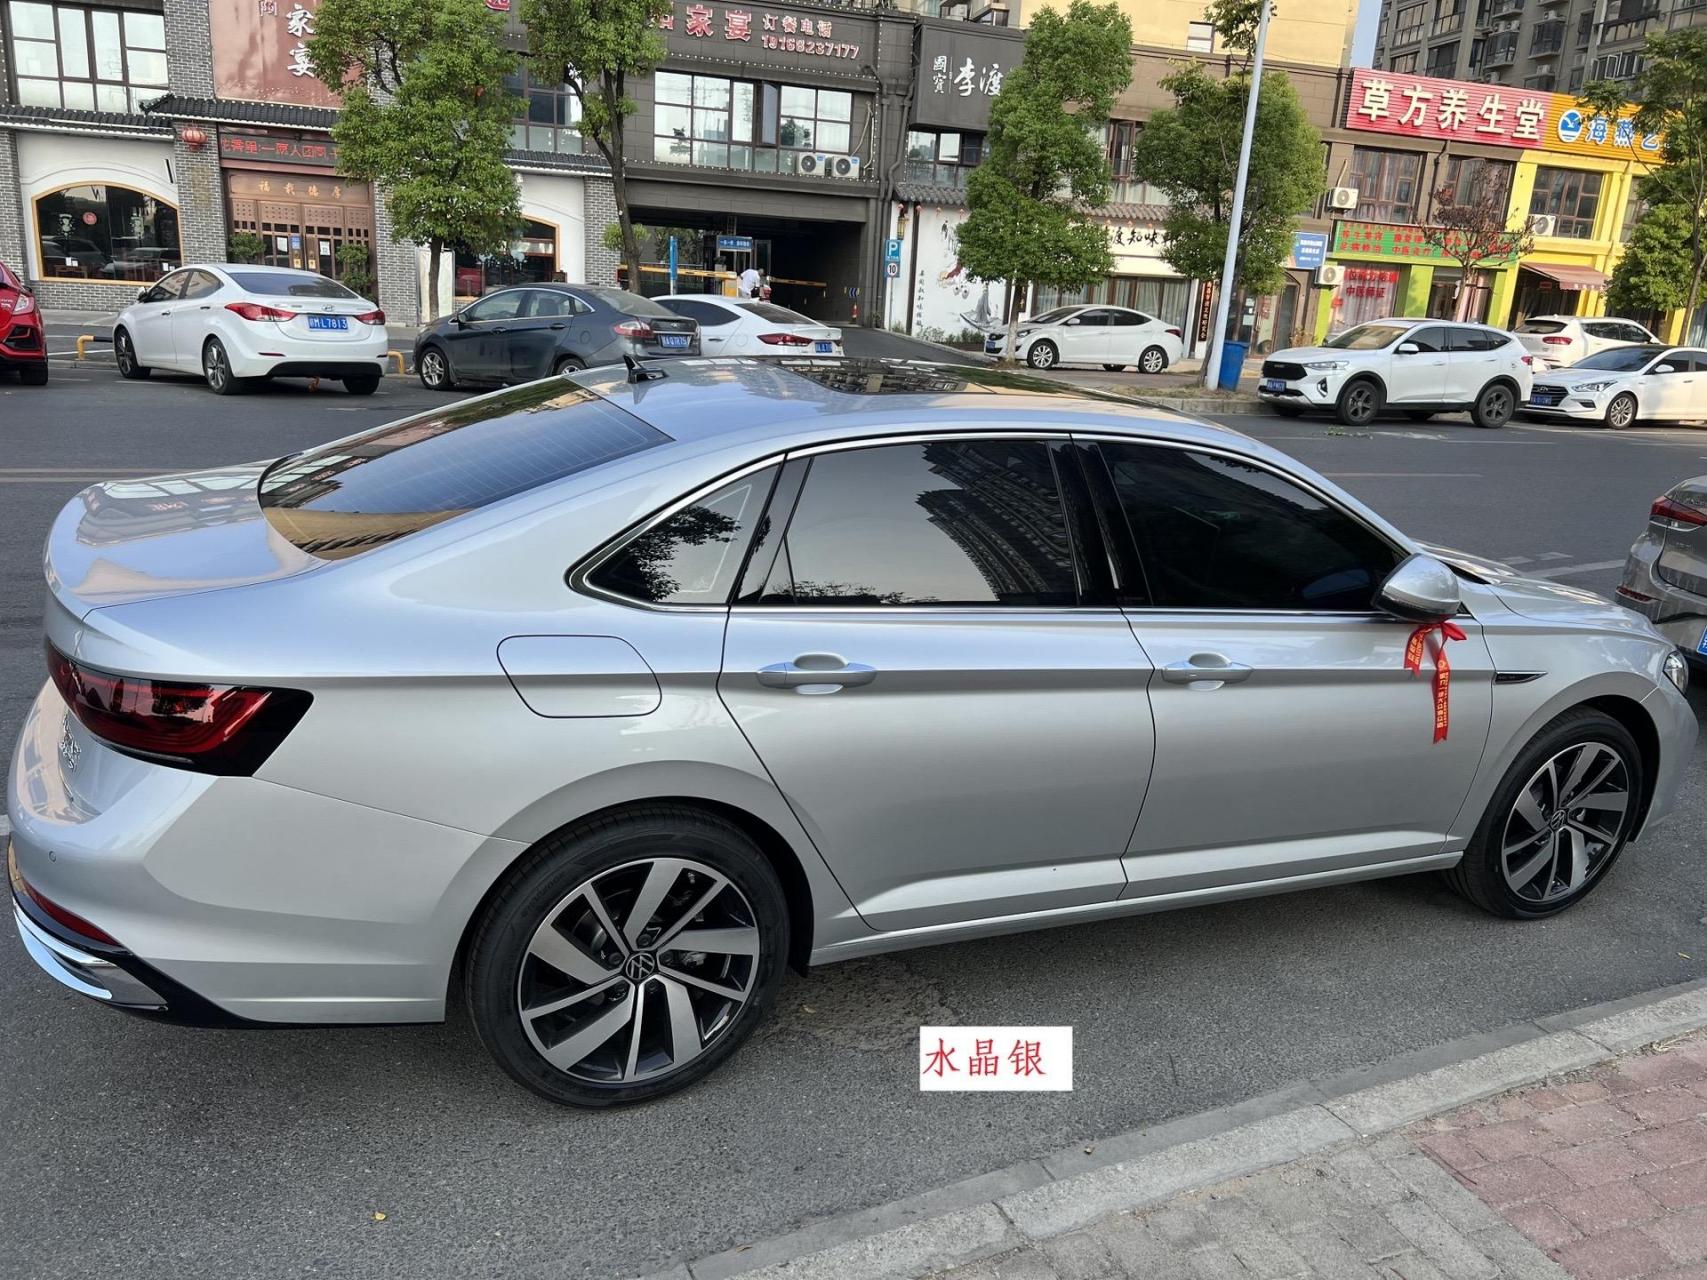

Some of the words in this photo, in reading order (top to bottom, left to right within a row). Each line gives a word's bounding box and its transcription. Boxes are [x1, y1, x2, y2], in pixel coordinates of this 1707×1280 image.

[762, 13, 833, 39] 订餐电话
[1358, 79, 1545, 140] 草方养生堂
[888, 241, 898, 256] P
[889, 264, 897, 275] 10
